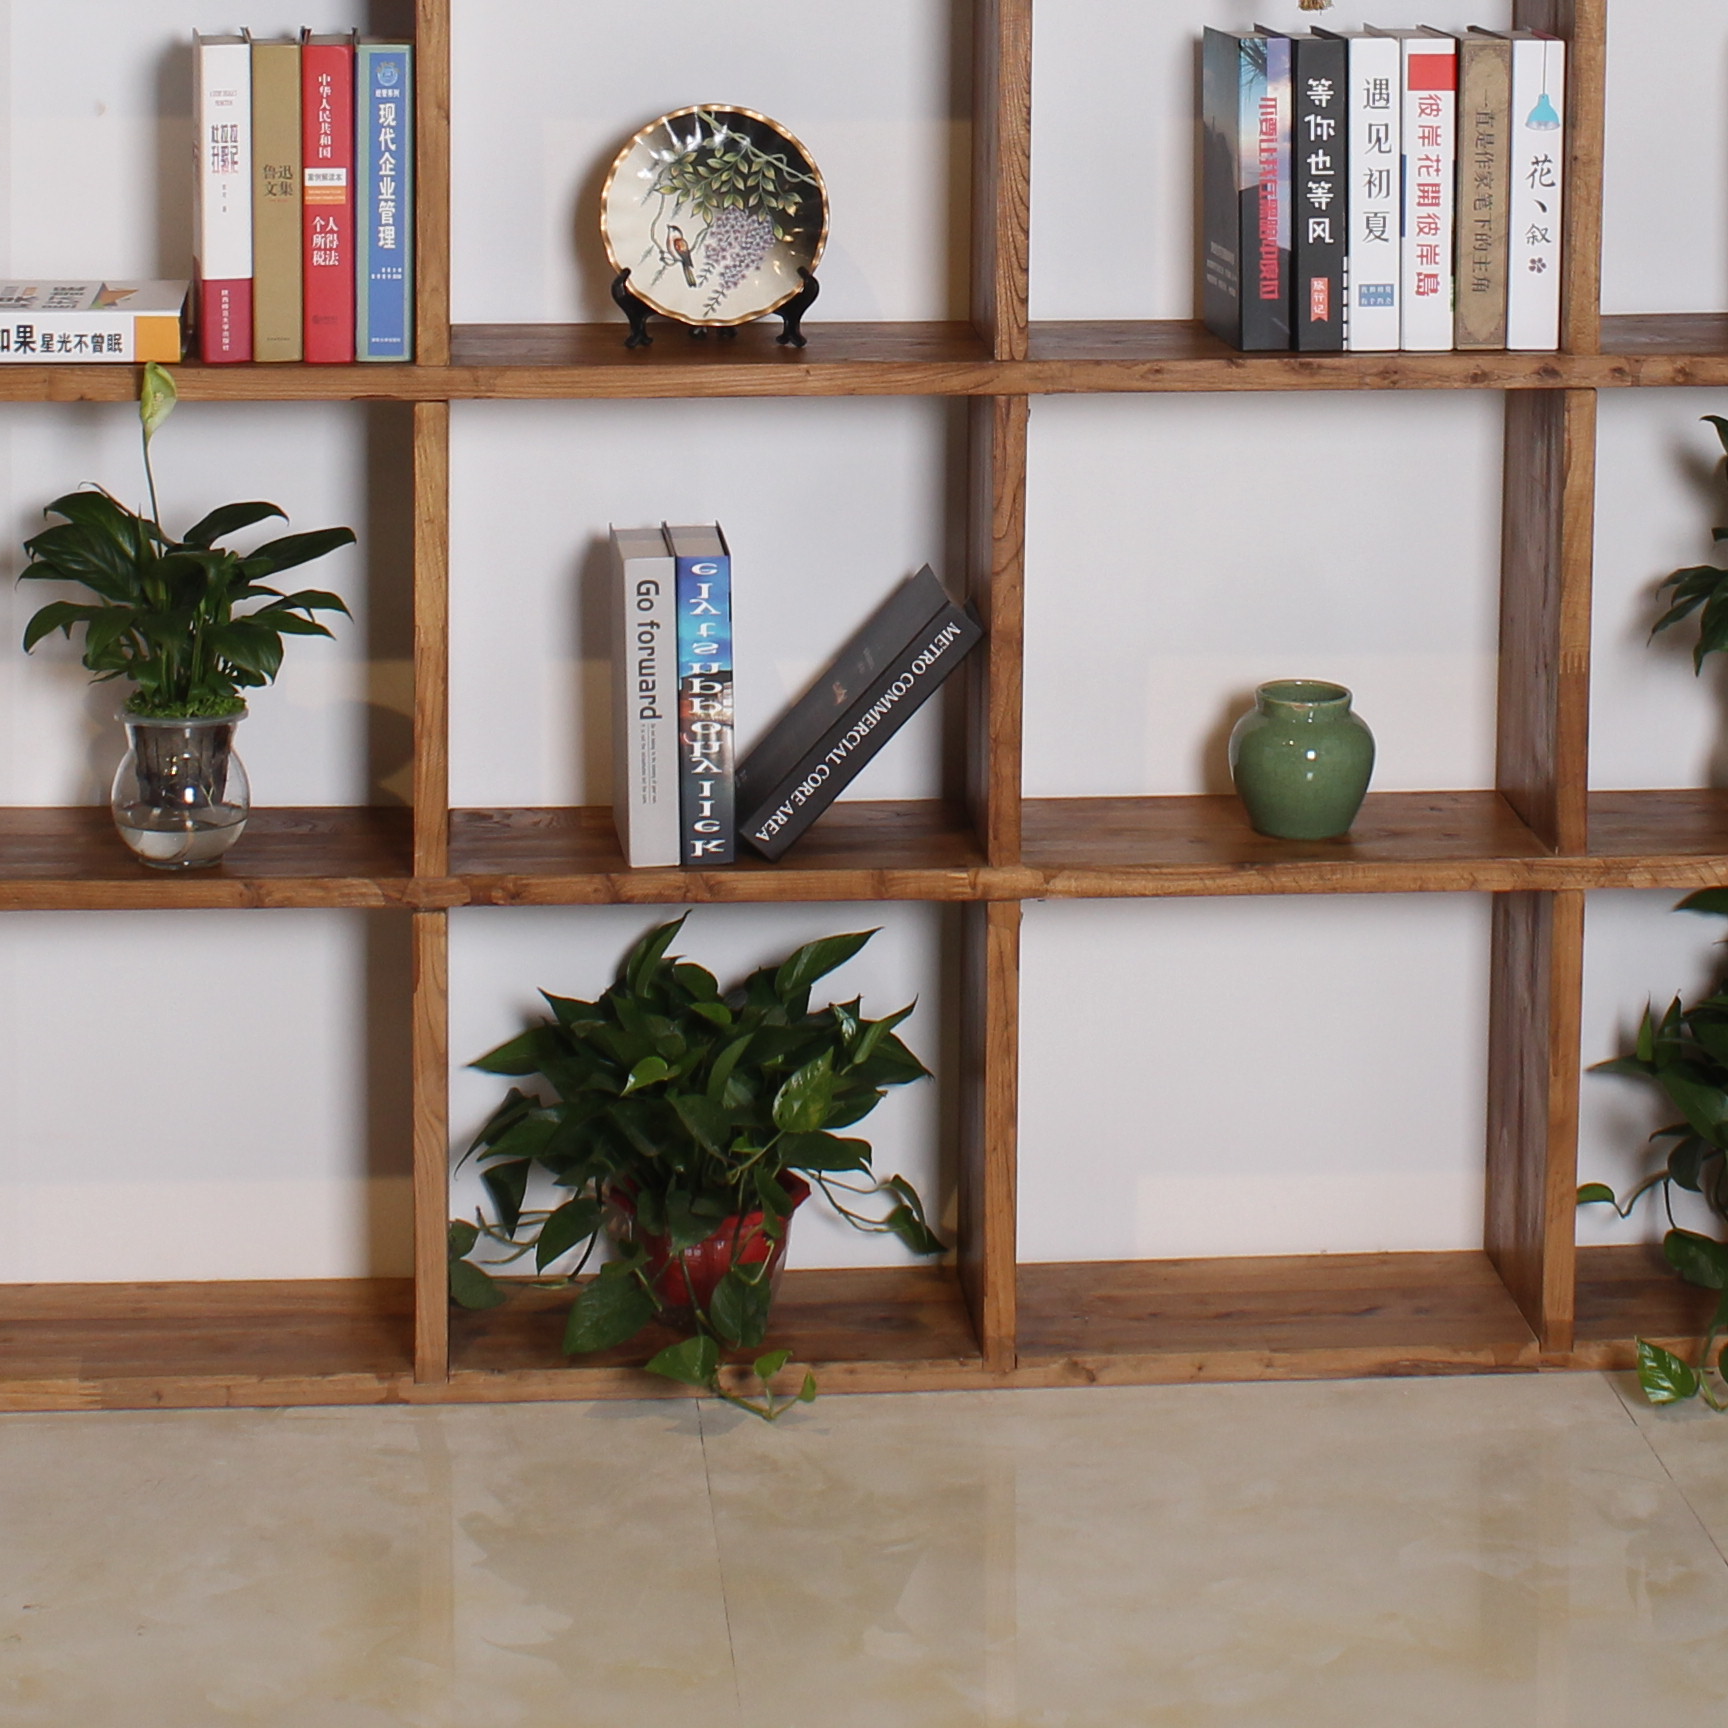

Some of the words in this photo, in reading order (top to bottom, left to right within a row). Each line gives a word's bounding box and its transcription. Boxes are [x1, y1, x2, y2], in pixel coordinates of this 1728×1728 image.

[318, 73, 332, 159] 中华人民共和国
[263, 164, 294, 180] 鲁迅
[378, 102, 398, 250] 现代企业管理
[1304, 77, 1336, 244] 等你也等风
[1362, 76, 1392, 244] 遇见初夏
[263, 180, 294, 197] 文集
[1415, 93, 1443, 297] 彼岸花開彼岸島
[1470, 88, 1495, 294] 一直是作家笔下的主角
[312, 216, 339, 232] 个人
[312, 233, 339, 249] 所得
[312, 250, 339, 267] 税法
[635, 579, 661, 612] Go
[637, 621, 663, 721] forward
[910, 621, 962, 675] METRO
[826, 672, 915, 766] COMMERCIAL
[791, 762, 833, 808] CORE
[754, 801, 797, 843] AREA
